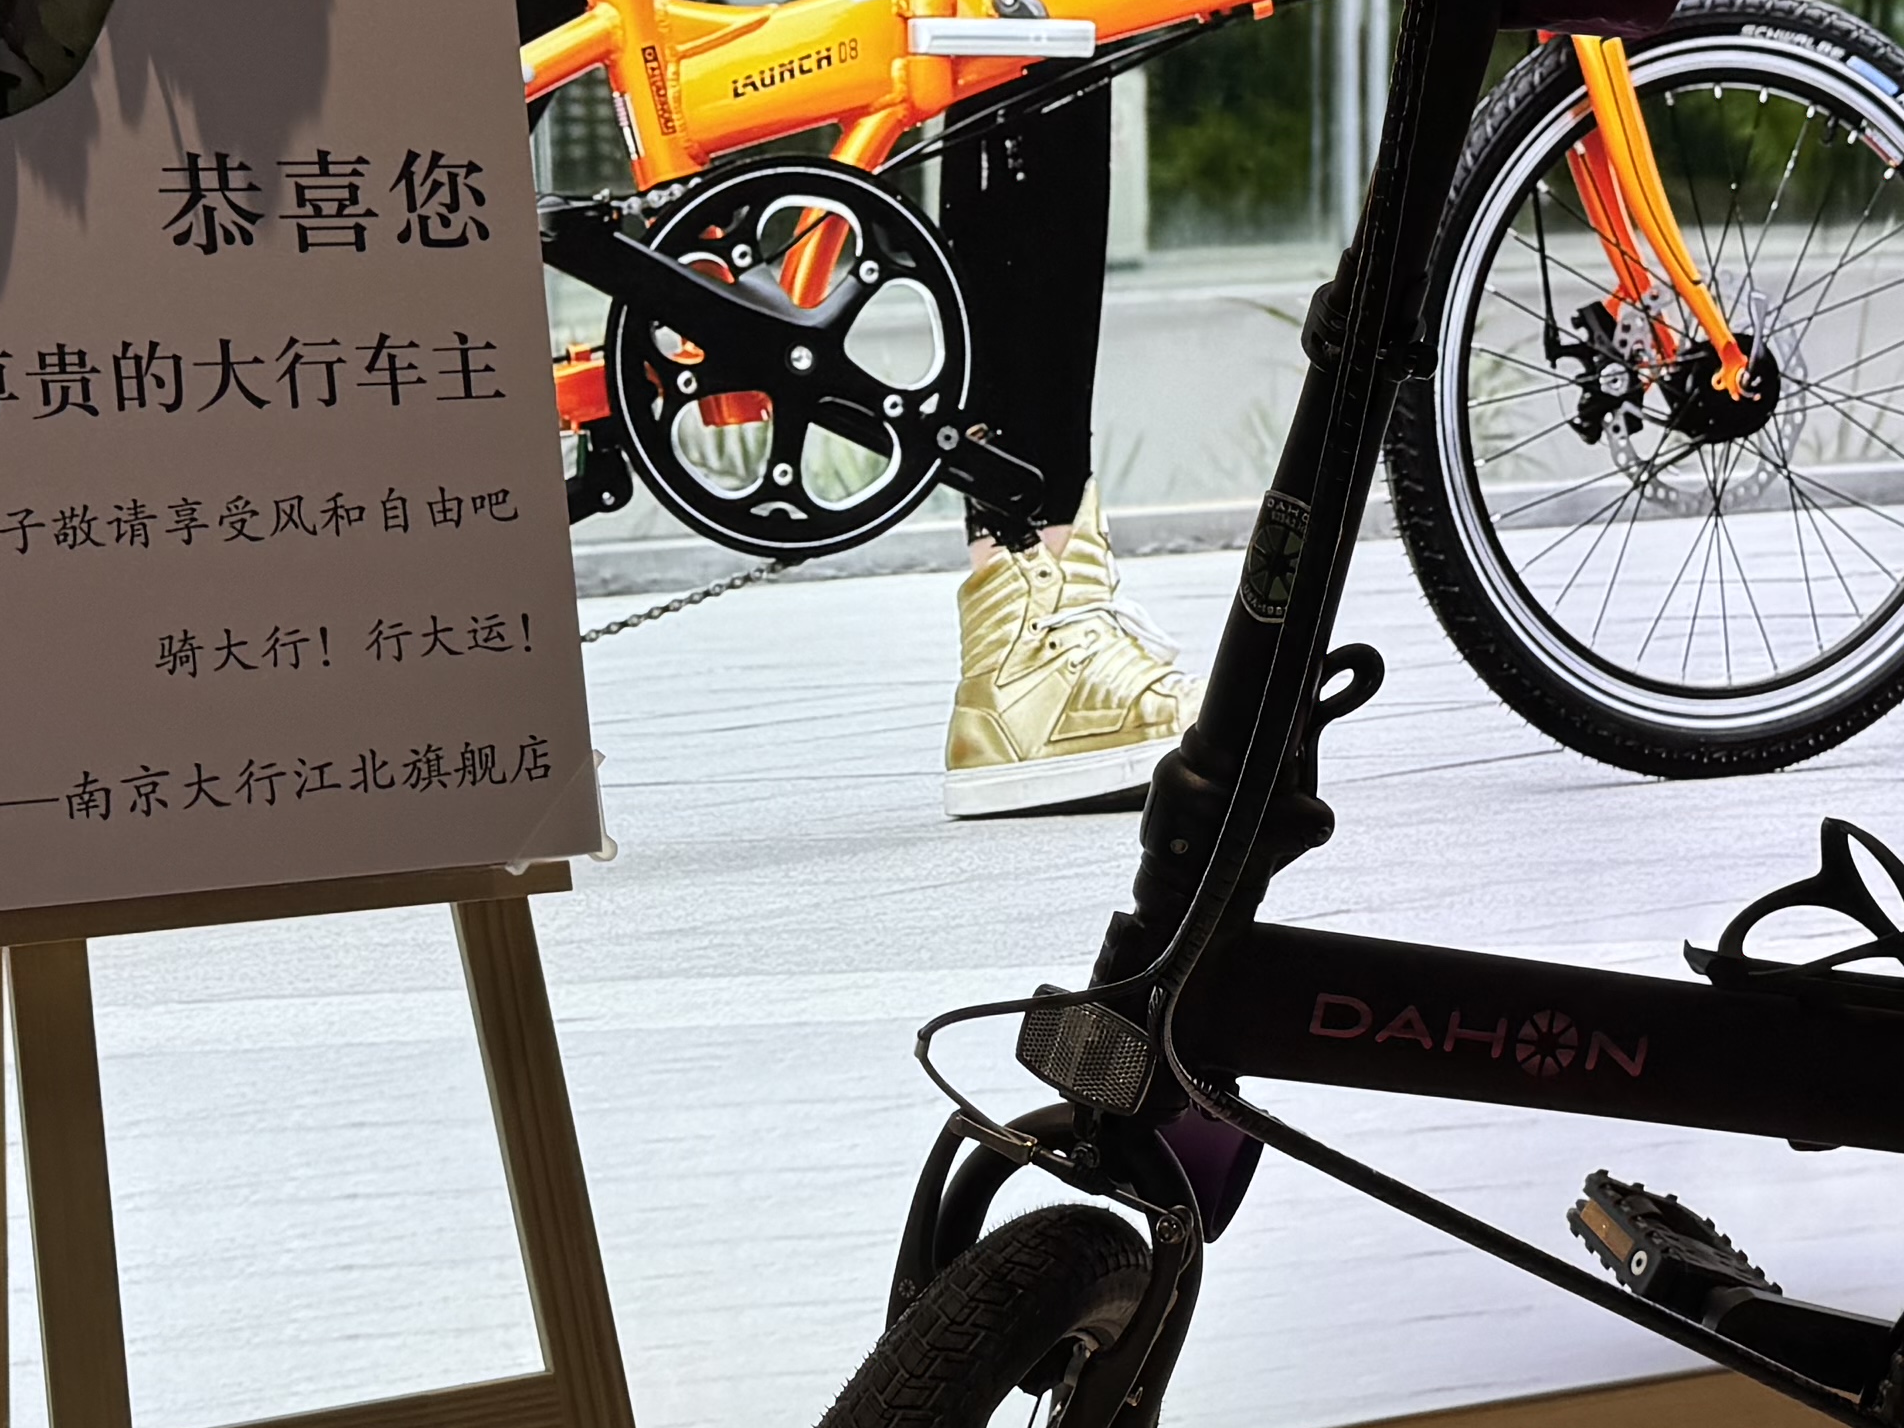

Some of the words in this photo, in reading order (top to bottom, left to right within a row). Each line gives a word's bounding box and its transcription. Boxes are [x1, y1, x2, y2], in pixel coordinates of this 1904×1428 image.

[730, 46, 833, 99] LAUNCH
[838, 37, 860, 64] 08
[1739, 23, 1848, 60] SCHWALBE
[157, 146, 492, 257] 恭喜您
[1306, 990, 1651, 1079] DAHON
